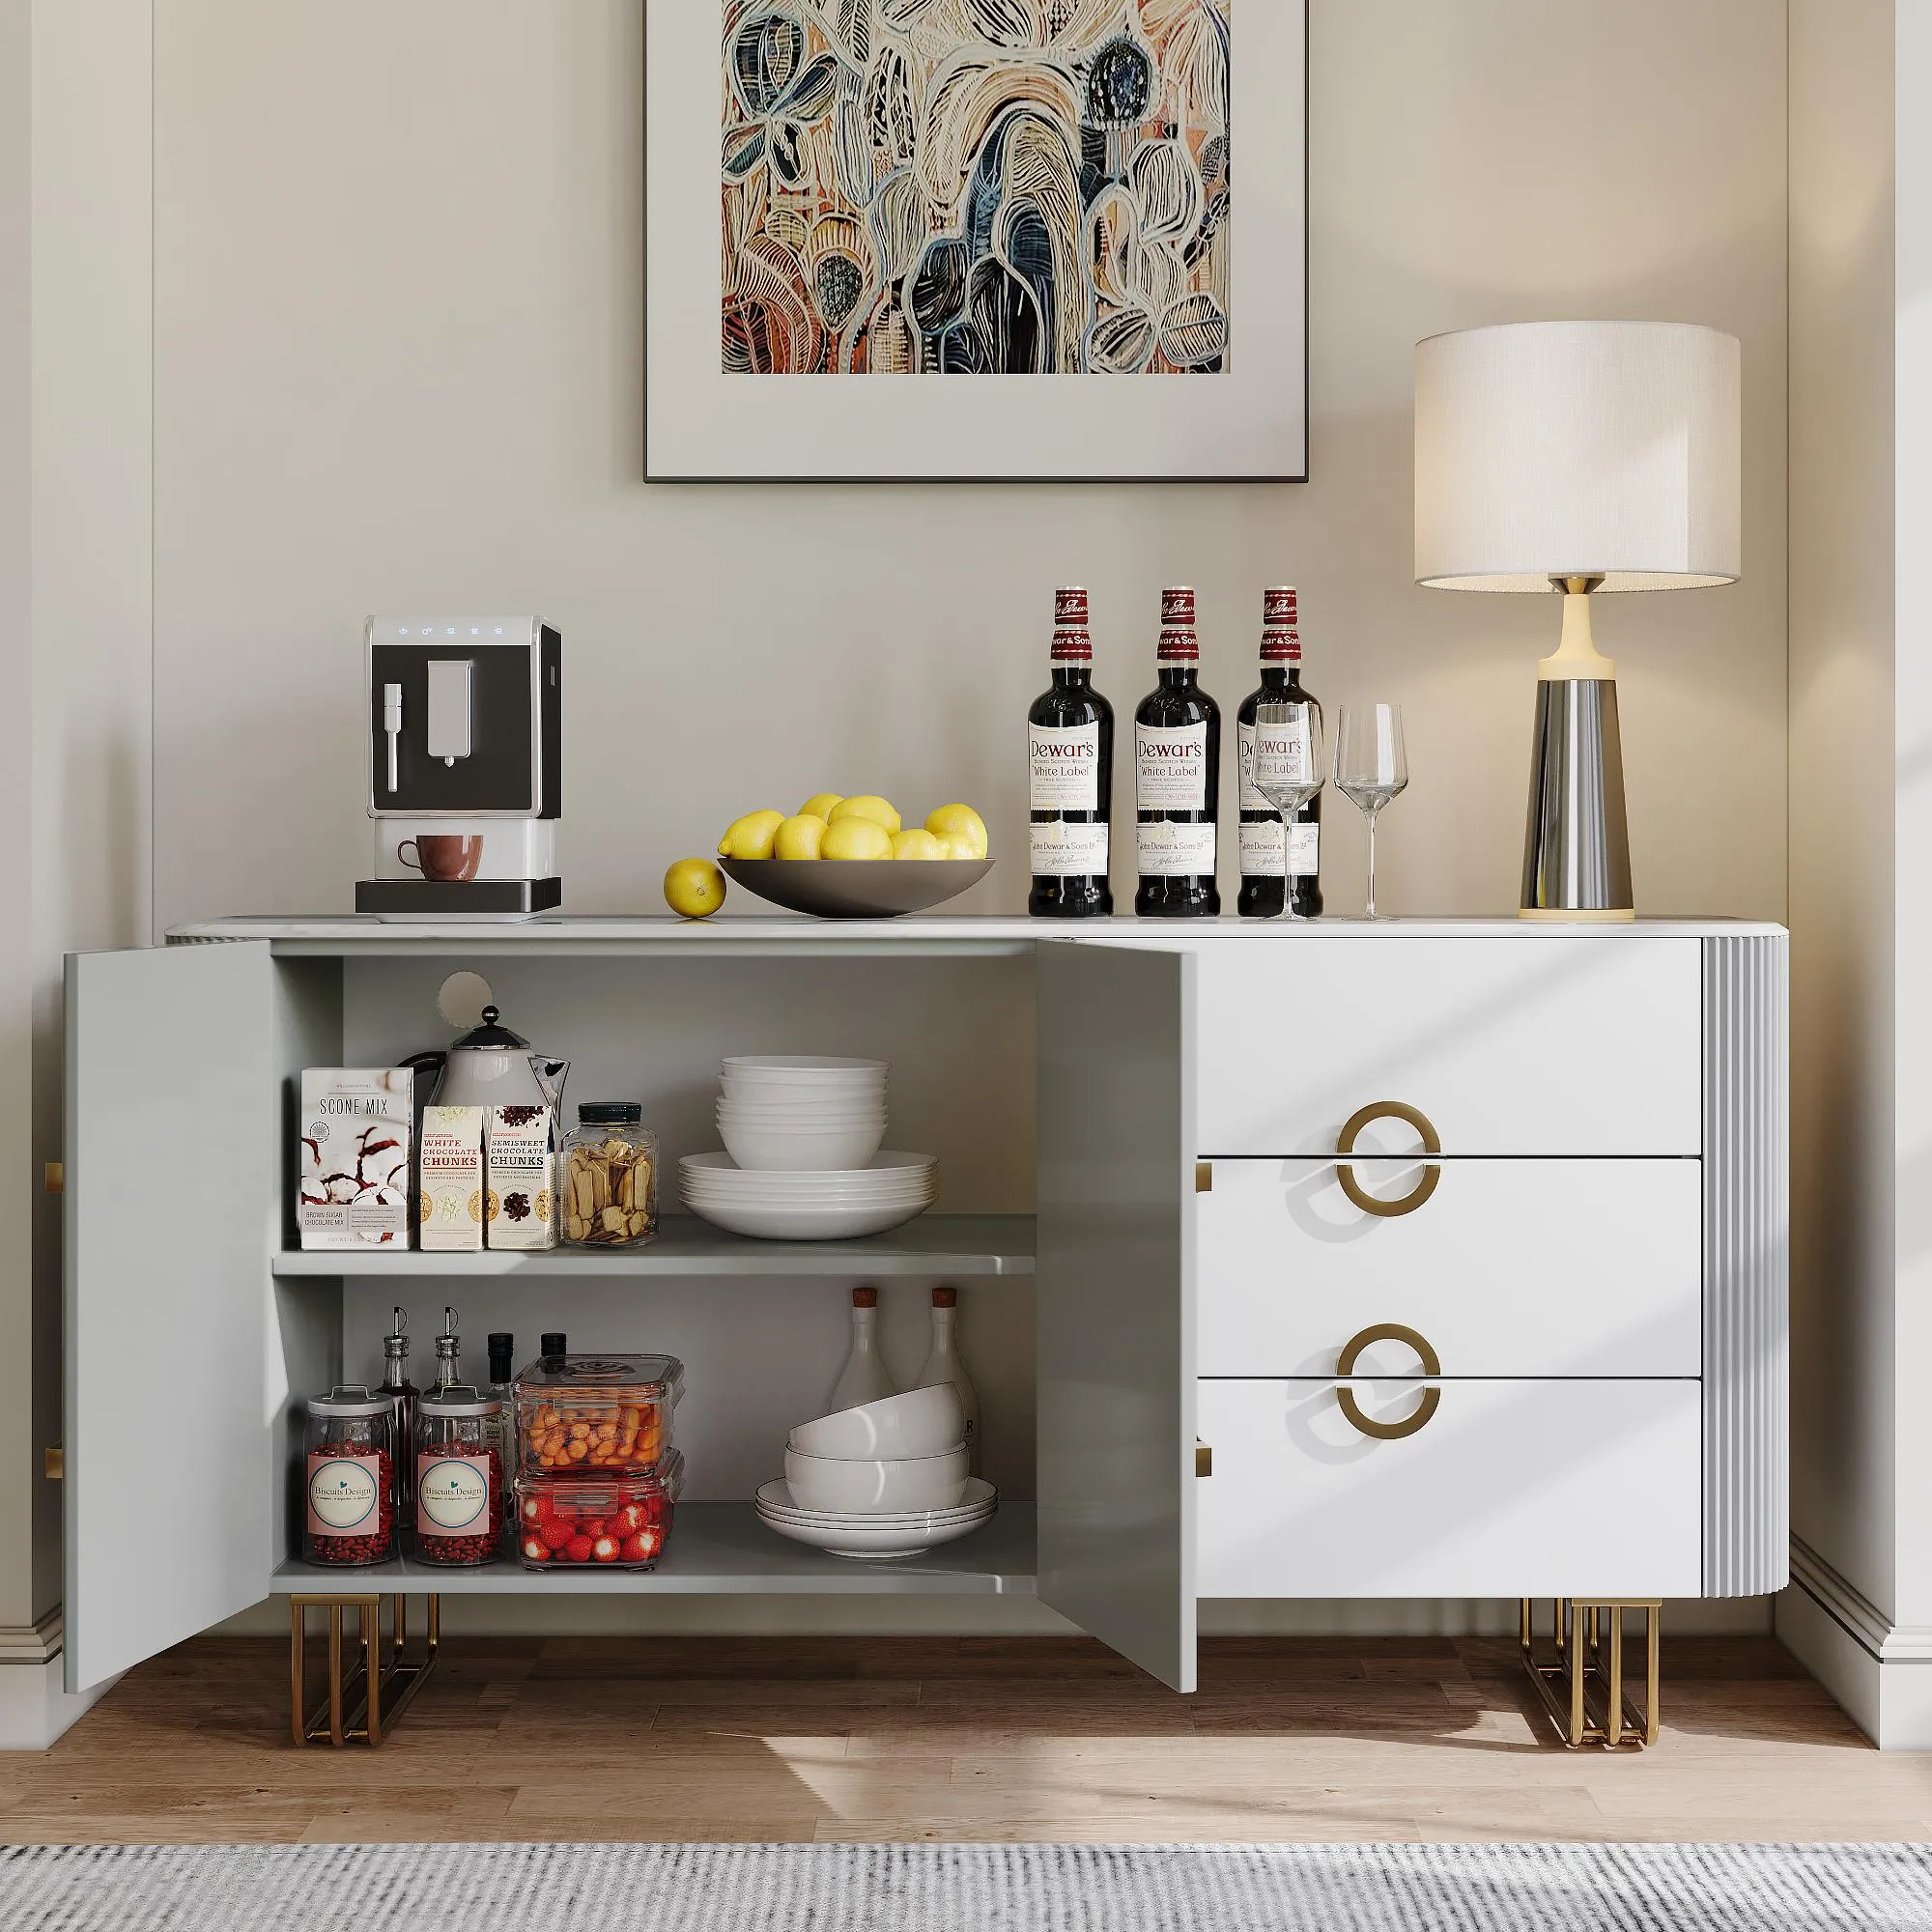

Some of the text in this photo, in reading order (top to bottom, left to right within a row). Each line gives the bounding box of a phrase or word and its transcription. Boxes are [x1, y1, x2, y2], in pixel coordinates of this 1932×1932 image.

[1032, 740, 1094, 756] Dewar's
[1139, 740, 1202, 756] Dewar's
[320, 1099, 387, 1114] SCONE MIX
[423, 1157, 477, 1166] CHUNKS
[491, 1156, 544, 1166] CHUNKS
[966, 1419, 974, 1433] R
[345, 1488, 371, 1496] Design
[456, 1488, 481, 1496] Design
